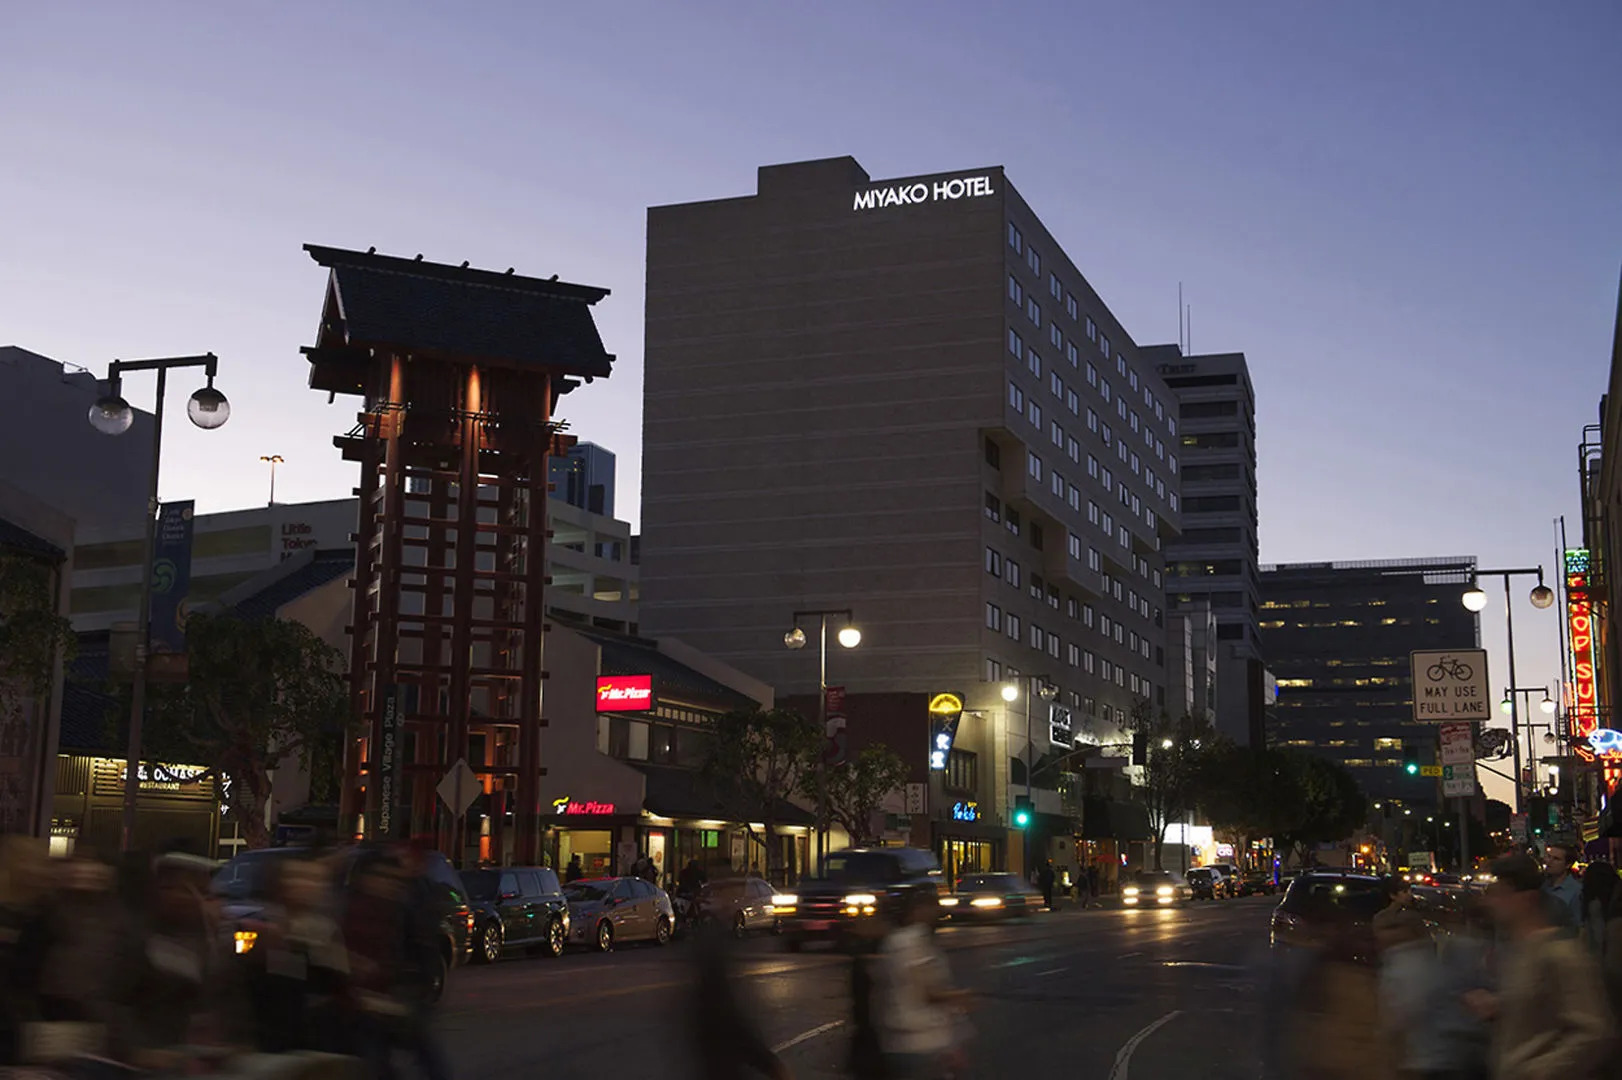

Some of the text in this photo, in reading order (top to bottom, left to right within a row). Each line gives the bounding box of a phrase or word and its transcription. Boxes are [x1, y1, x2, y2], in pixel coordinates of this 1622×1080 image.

[854, 176, 994, 211] MIYAKO HOTEL
[1420, 701, 1483, 714] FULL LANE
[1425, 685, 1477, 698] MAY USE
[1576, 663, 1596, 737] SUEY
[379, 697, 396, 834] Japanese Village Plaza
